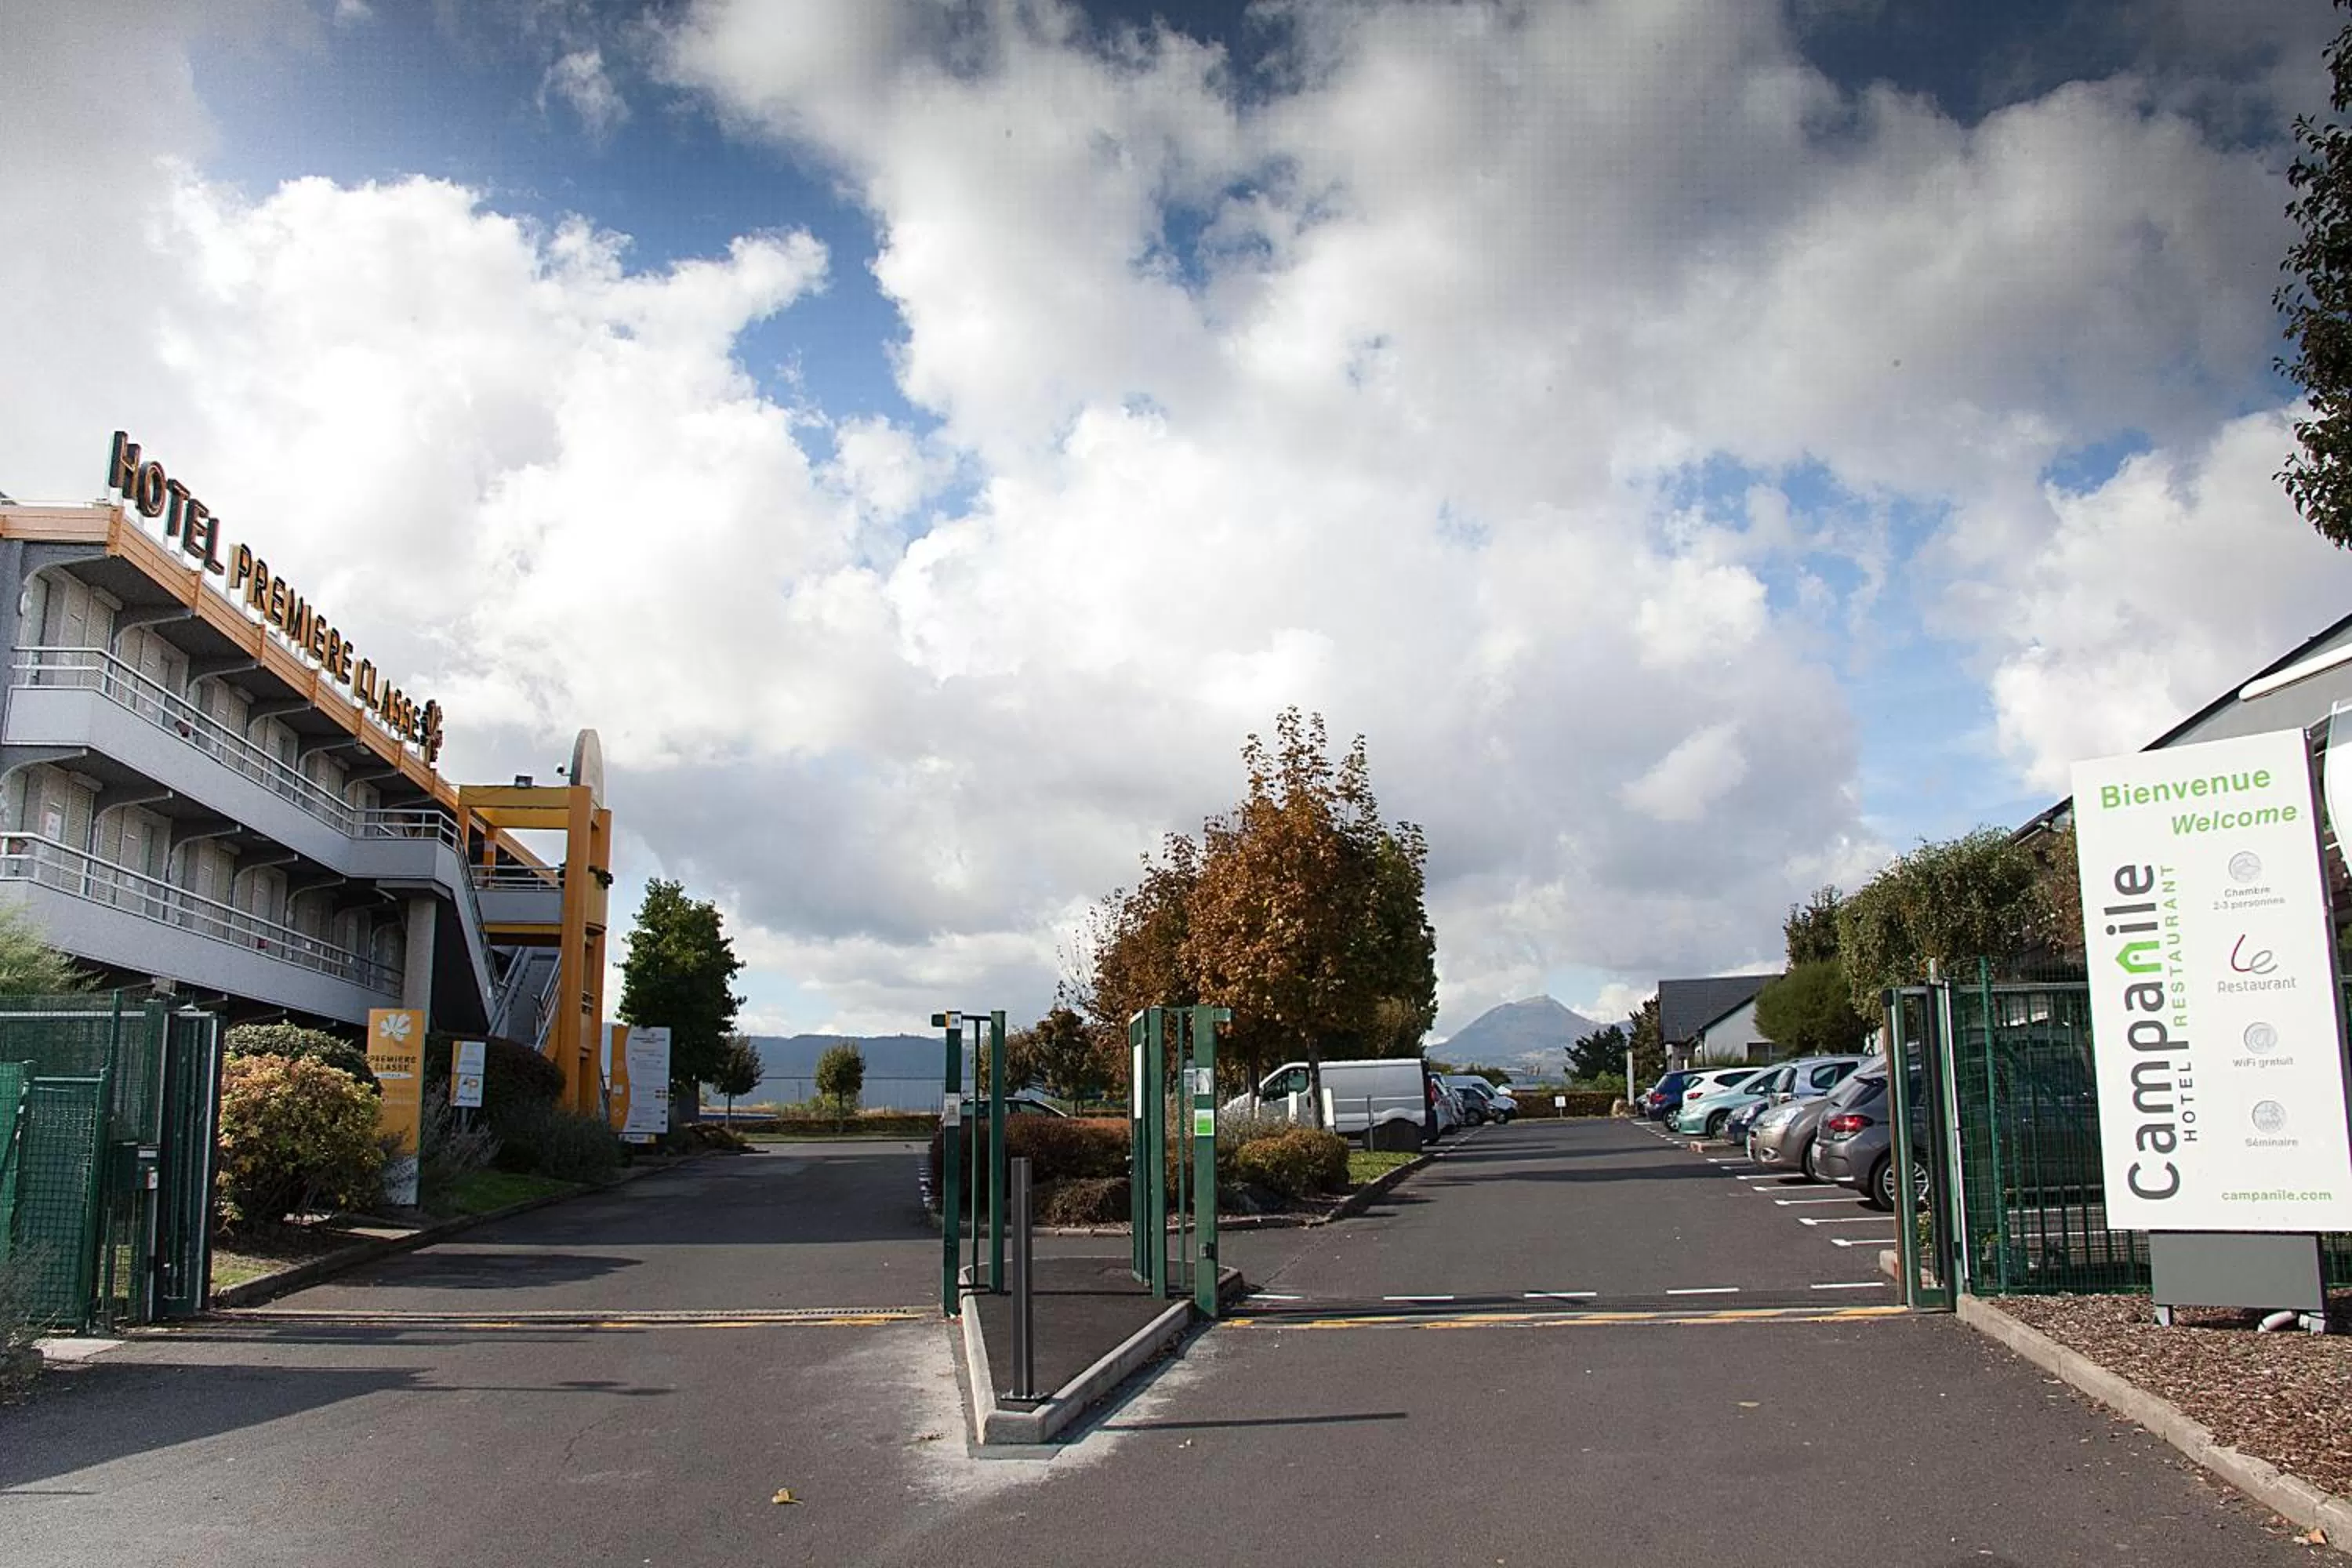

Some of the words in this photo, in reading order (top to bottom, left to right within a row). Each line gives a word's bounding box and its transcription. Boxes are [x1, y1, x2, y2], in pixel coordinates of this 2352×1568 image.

[108, 430, 224, 576] HOTEL
[229, 543, 353, 685] PREMIERE
[355, 657, 421, 743] CLASSE
[2101, 769, 2270, 808] Bienvenue
[2172, 805, 2297, 835] Welcome
[2225, 887, 2270, 897] Chambre
[2231, 897, 2285, 909] personnes
[2160, 866, 2187, 1027] RESTAURANT
[2217, 978, 2296, 993] Restaurant
[2103, 864, 2190, 1200] Campanile
[2233, 1058, 2256, 1067] WiFi
[2259, 1057, 2293, 1068] gratuit
[2178, 1062, 2198, 1142] HOTEL
[2245, 1137, 2298, 1146] Séminaire
[2221, 1189, 2332, 1202] campanile.com
